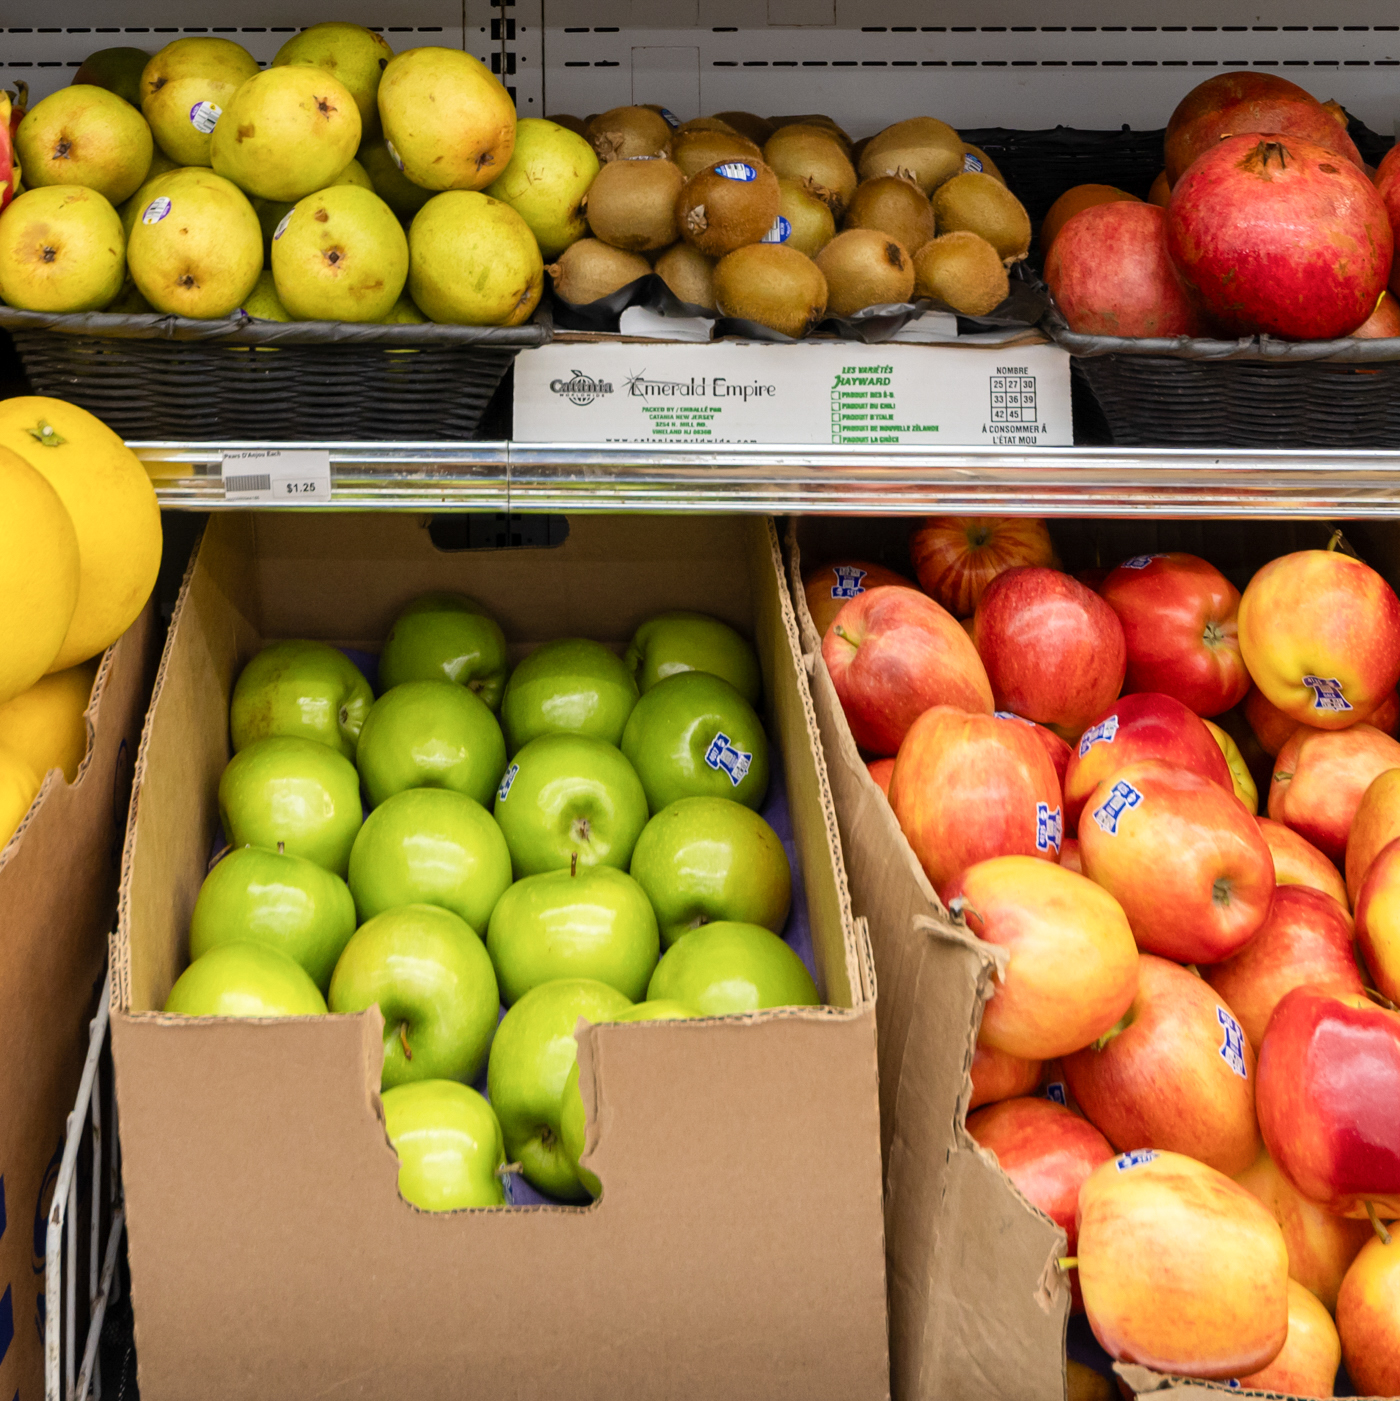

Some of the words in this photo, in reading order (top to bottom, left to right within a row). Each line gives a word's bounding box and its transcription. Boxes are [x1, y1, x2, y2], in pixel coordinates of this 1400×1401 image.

[842, 366, 856, 374] LES
[858, 364, 893, 374] VARIÉTÉS
[996, 367, 1028, 375] NOMBRE
[550, 379, 614, 394] Catania
[631, 377, 706, 398] Emerald
[713, 377, 776, 402] Empire
[992, 434, 1016, 444] L'ÉTAT
[1018, 436, 1037, 444] MOU
[286, 482, 316, 493] $1.25
